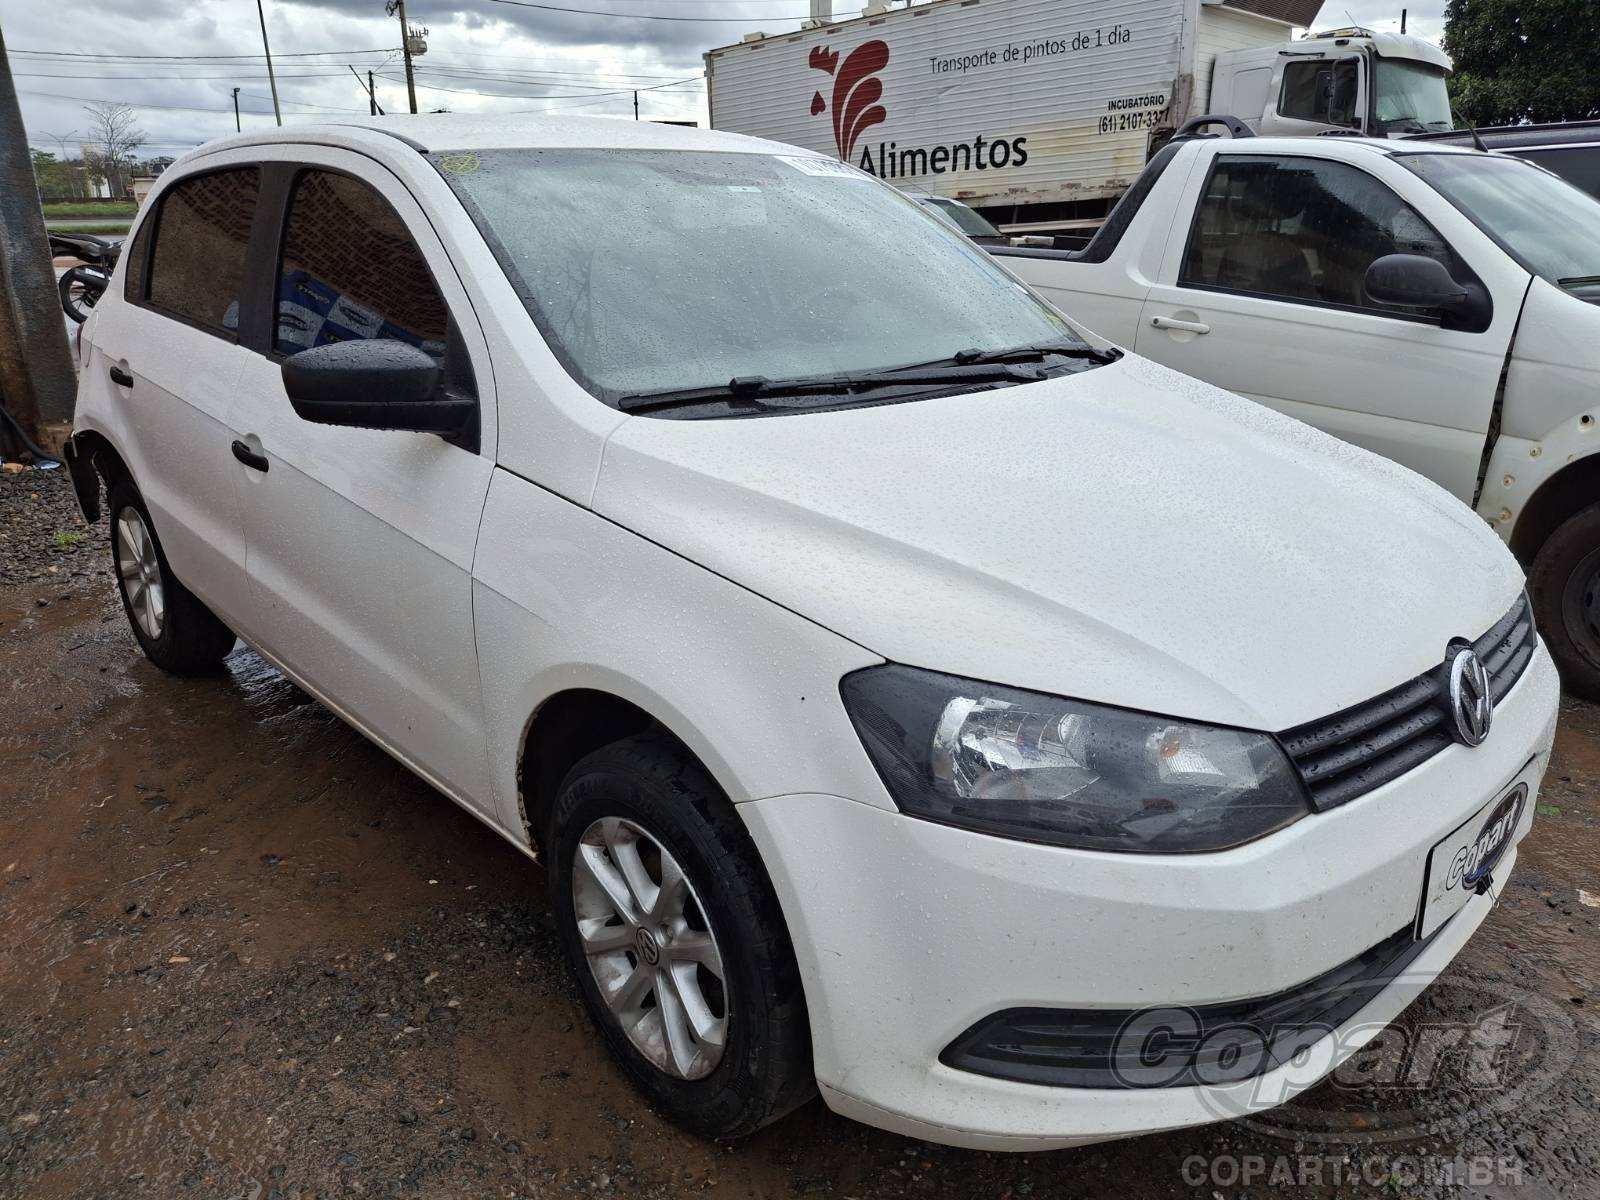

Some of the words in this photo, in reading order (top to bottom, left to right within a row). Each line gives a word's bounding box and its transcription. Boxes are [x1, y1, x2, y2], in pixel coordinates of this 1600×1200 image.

[930, 50, 997, 74] Transporte
[1003, 43, 1019, 62] de
[1024, 40, 1066, 63] pintos
[1071, 32, 1090, 51] de
[1095, 29, 1103, 47] 1
[1108, 25, 1131, 45] dia
[1108, 92, 1164, 111] INCUBATÓRIO
[1098, 114, 1117, 135] (61)
[859, 134, 1028, 179] Alimentos
[1446, 790, 1522, 891] Copart
